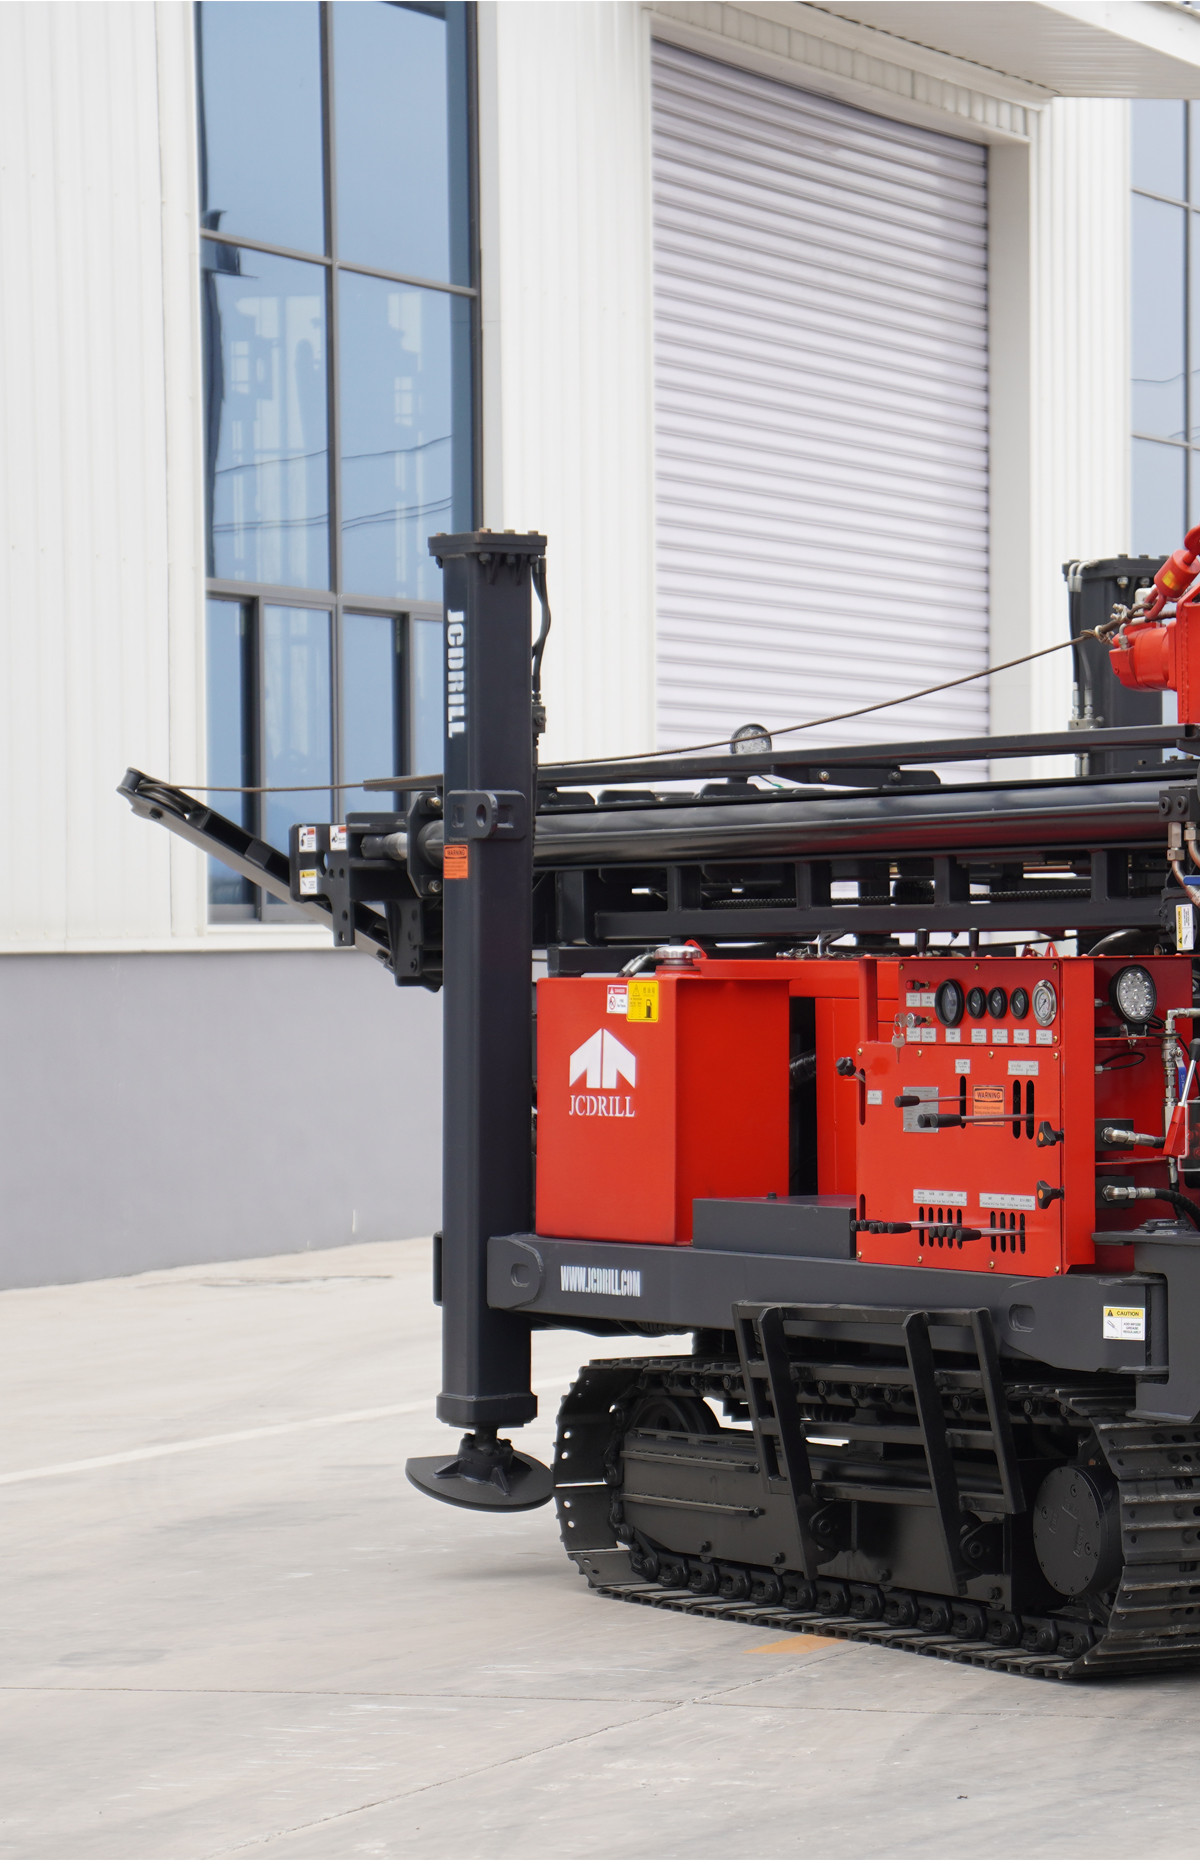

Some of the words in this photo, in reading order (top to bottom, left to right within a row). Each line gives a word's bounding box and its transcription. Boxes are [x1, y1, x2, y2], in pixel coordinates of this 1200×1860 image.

[447, 609, 465, 738] JCDRILL
[569, 1095, 636, 1117] JCDRILL
[560, 1265, 640, 1297] WWW.JCDRILL.COM
